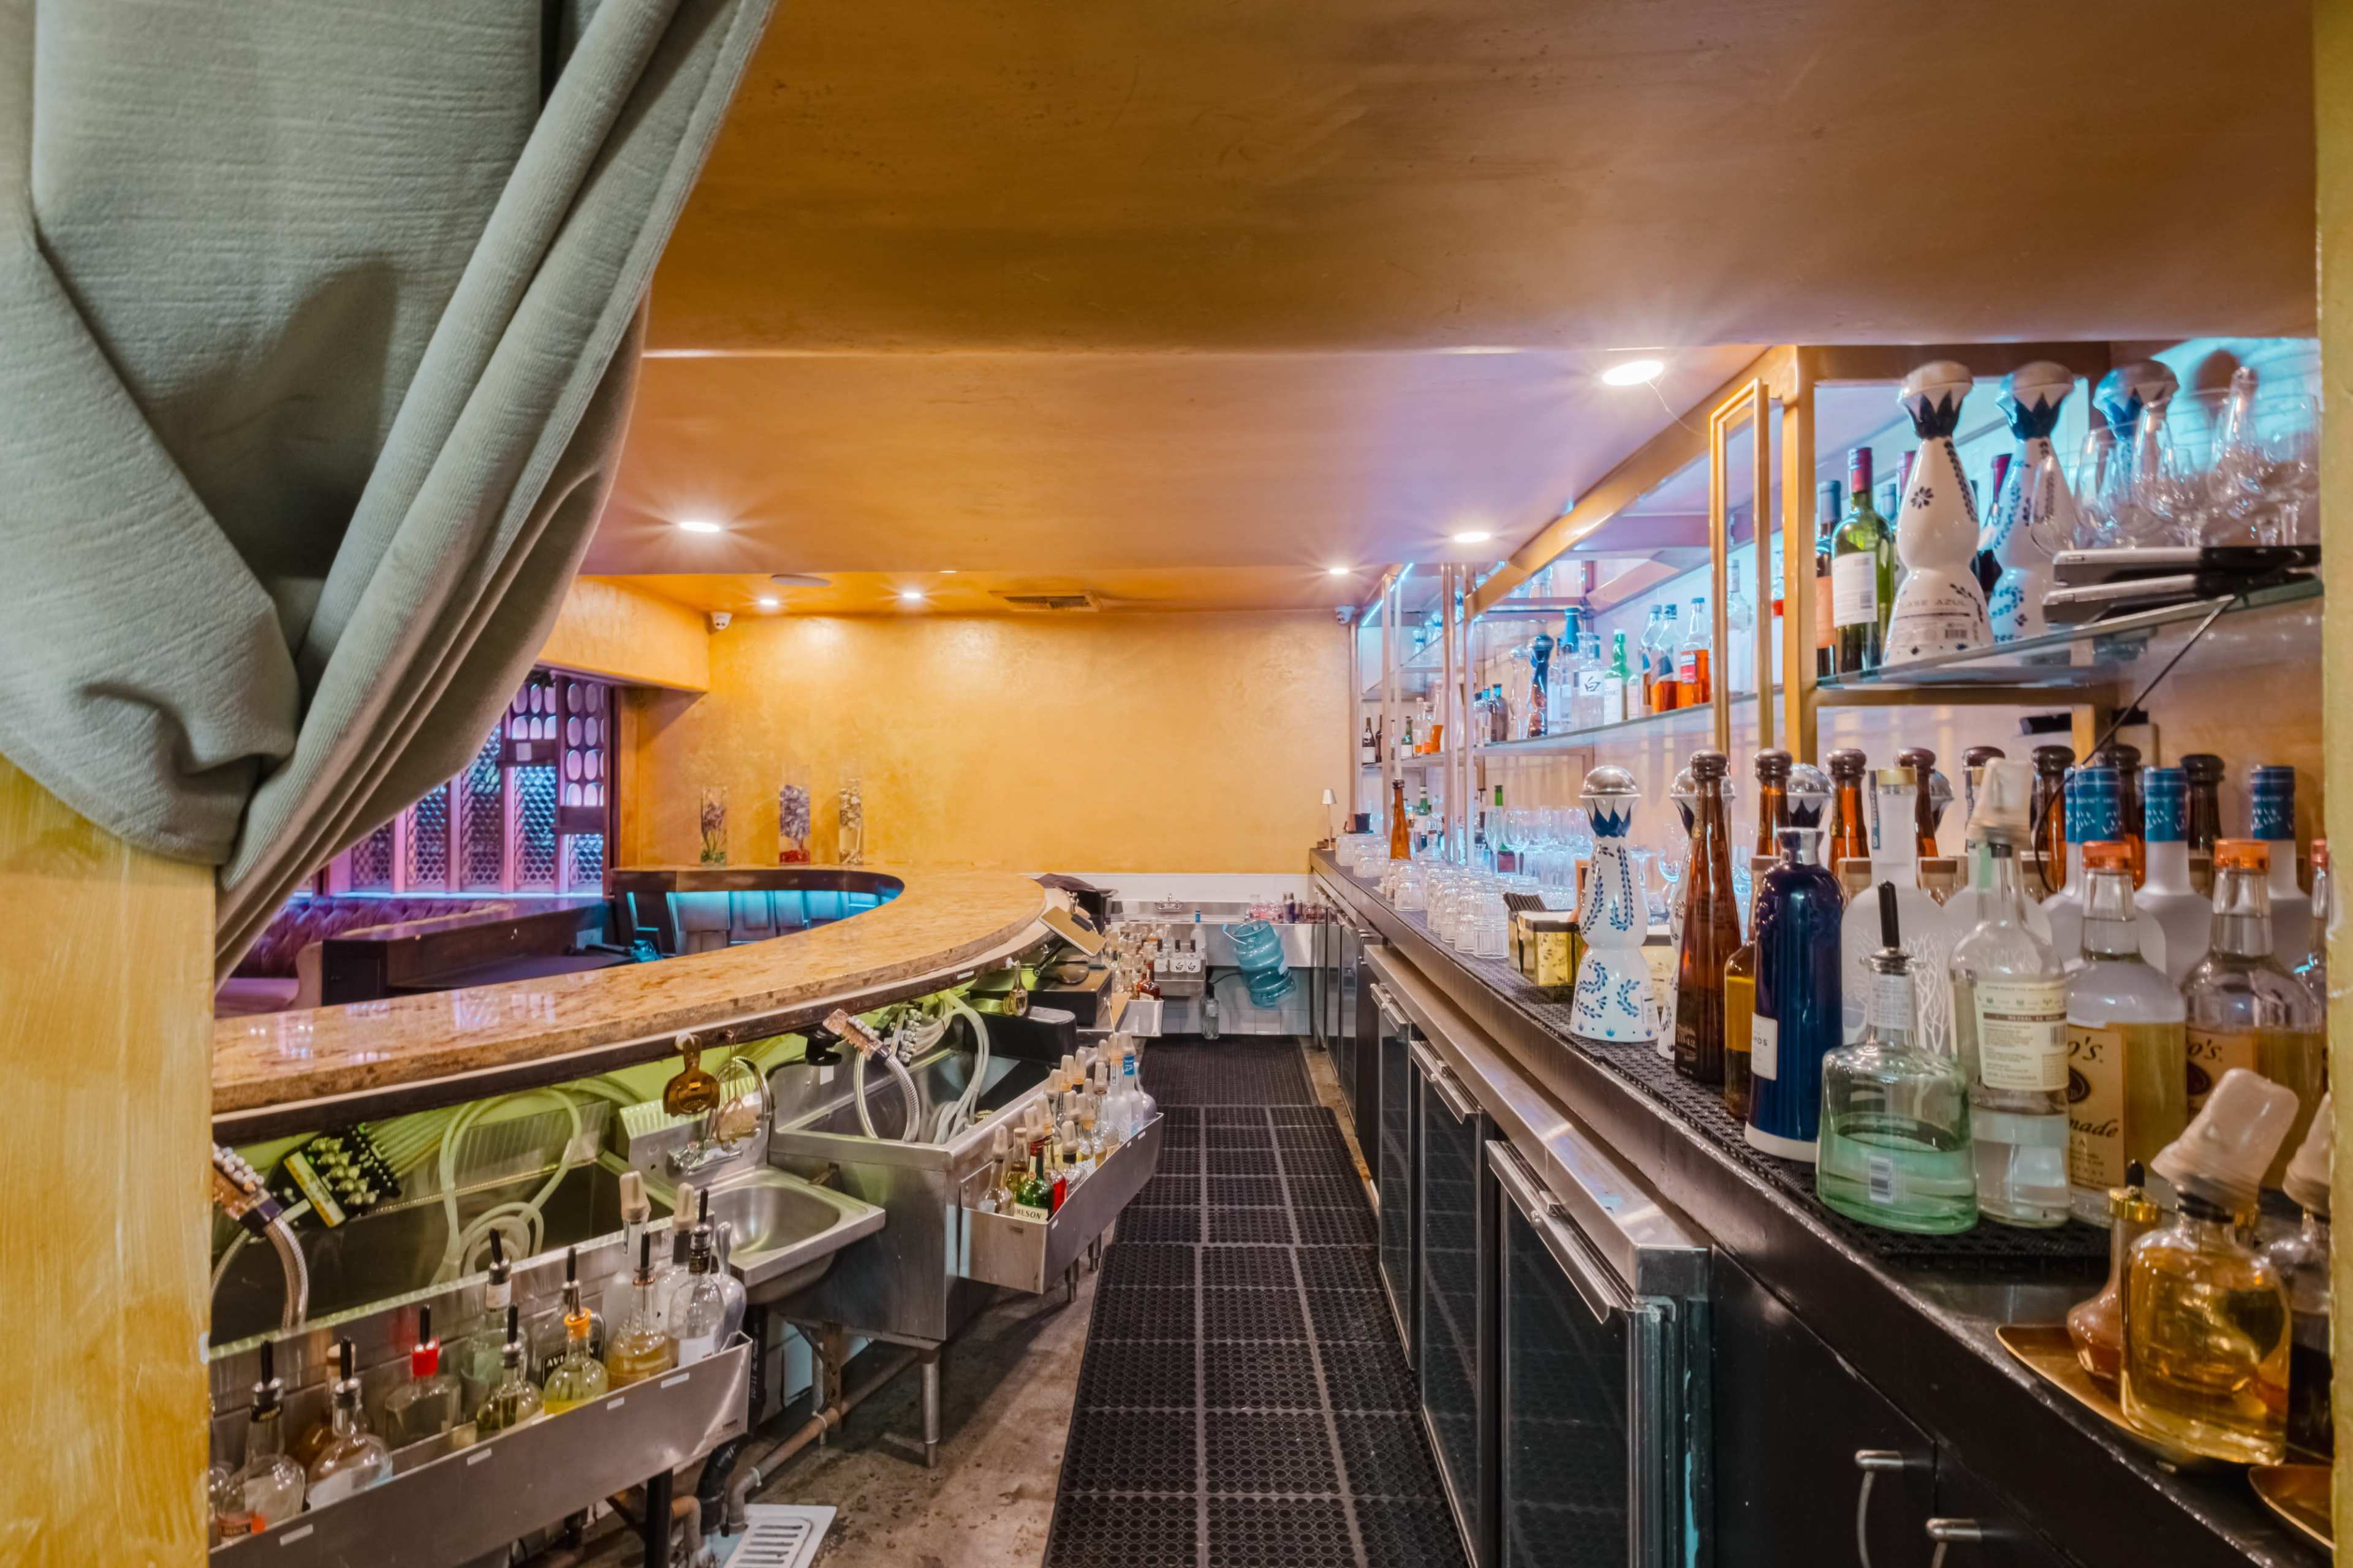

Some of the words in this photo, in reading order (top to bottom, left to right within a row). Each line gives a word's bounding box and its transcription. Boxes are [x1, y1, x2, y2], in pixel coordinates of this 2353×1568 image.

[2068, 1036, 2102, 1061] o's
[2188, 1039, 2222, 1060] o's
[2069, 1119, 2118, 1138] made
[1015, 1208, 1042, 1219] MESON
